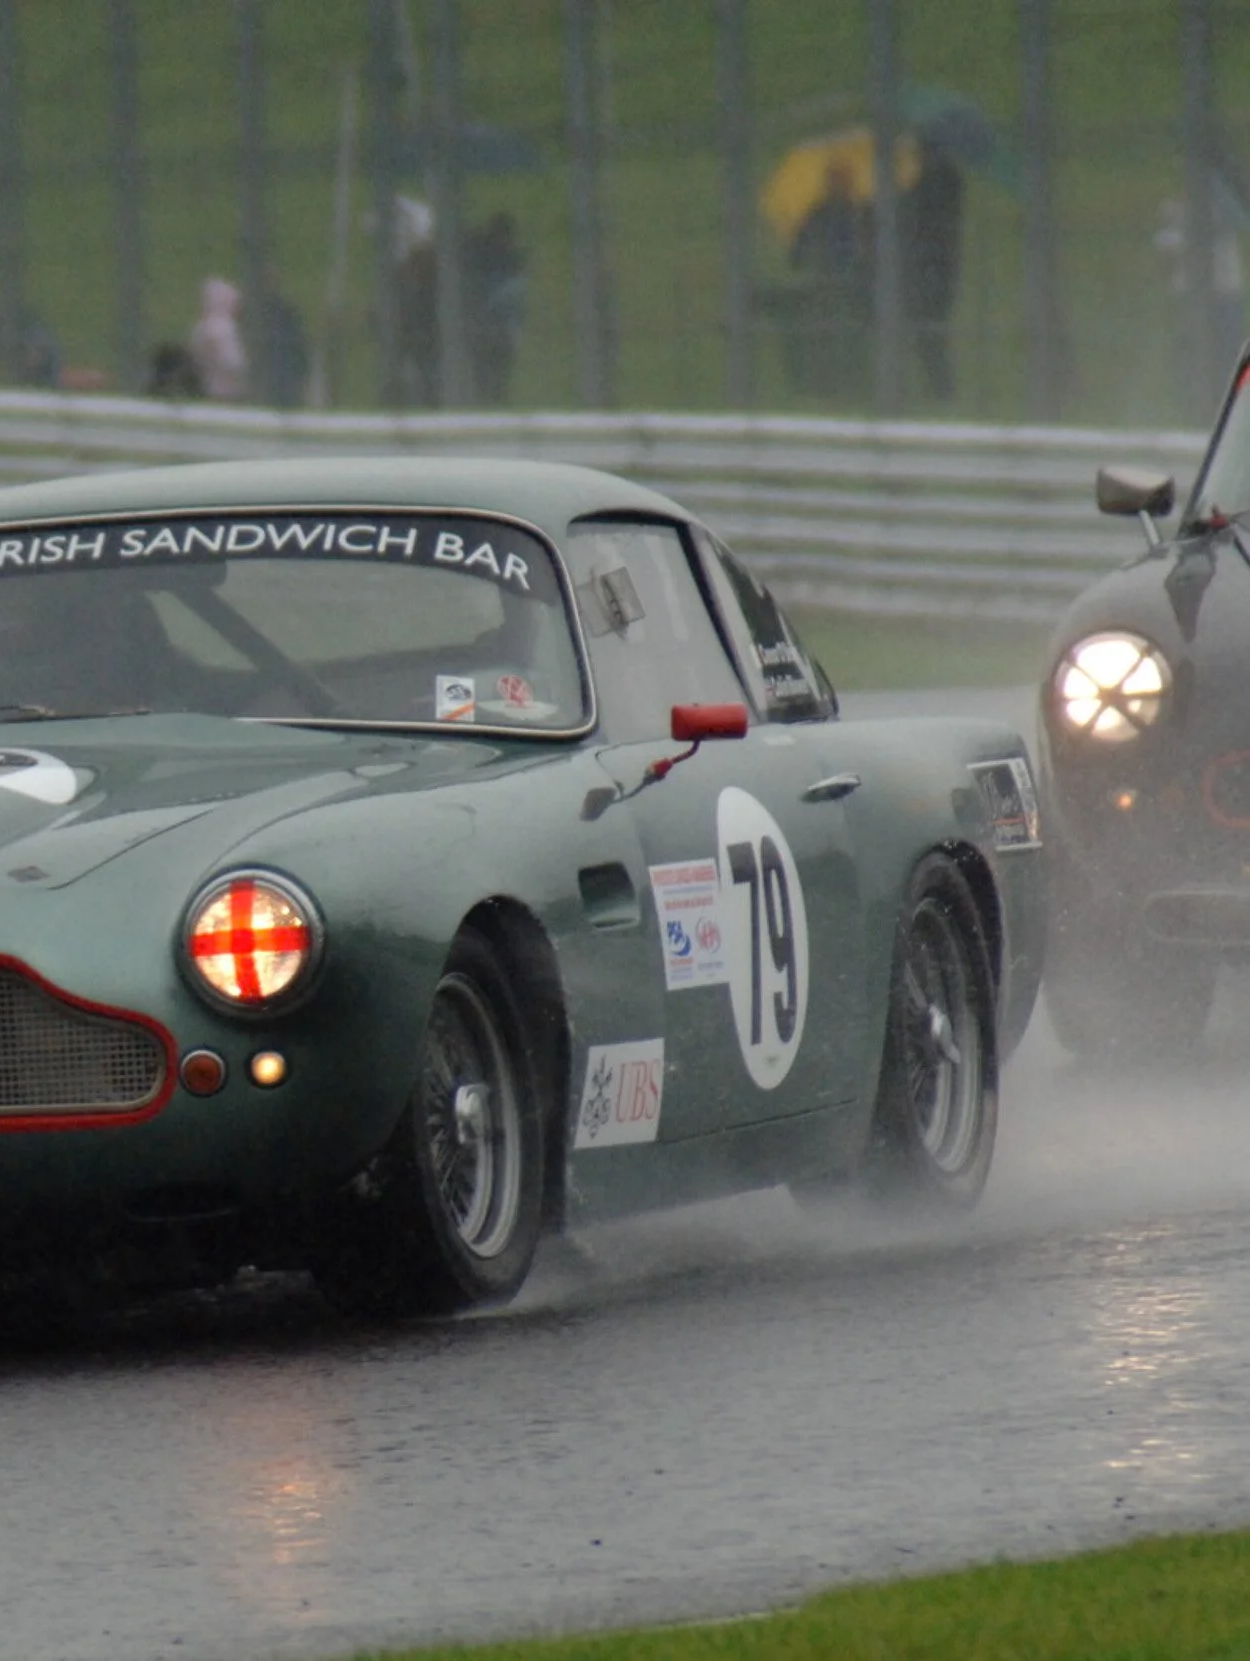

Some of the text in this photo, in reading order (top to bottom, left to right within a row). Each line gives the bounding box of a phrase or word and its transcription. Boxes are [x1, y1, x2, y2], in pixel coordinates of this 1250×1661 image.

[119, 523, 418, 557] SANDWICH
[434, 532, 530, 590] BAR
[726, 835, 798, 1045] 79
[616, 1058, 659, 1124] UBS
